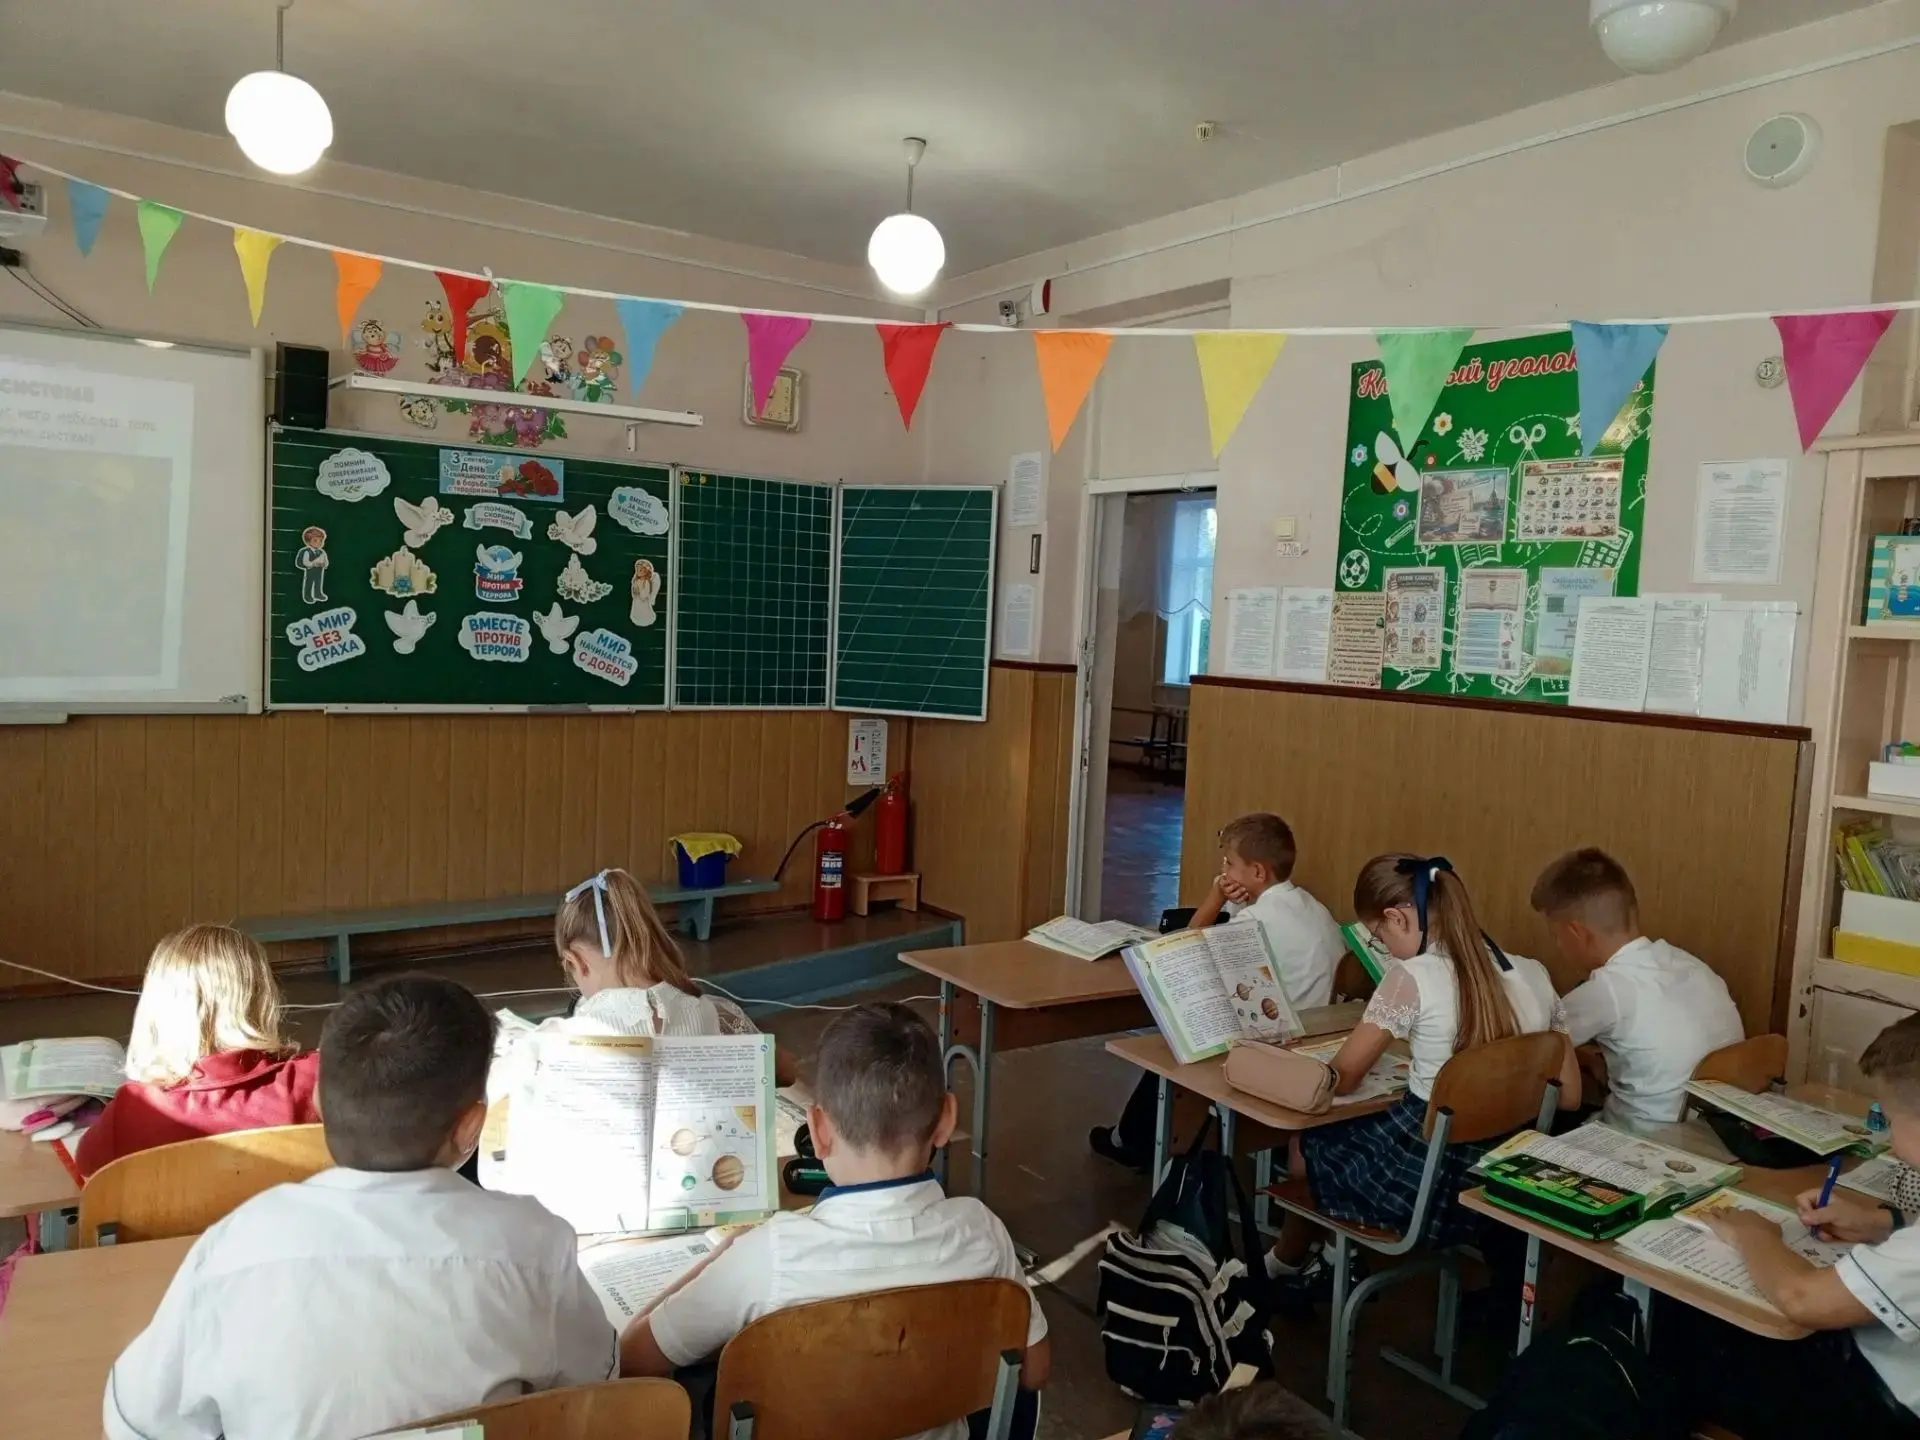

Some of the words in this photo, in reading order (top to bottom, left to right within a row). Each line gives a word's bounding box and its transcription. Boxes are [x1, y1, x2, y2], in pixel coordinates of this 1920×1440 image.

[334, 459, 366, 468] ПОМНИМ
[452, 452, 460, 464] 3
[460, 462, 485, 473] День
[484, 506, 516, 516] ПОМНИМ
[484, 512, 515, 522] СКОРБИМ
[481, 581, 510, 590] ПРОТИВ
[482, 590, 512, 599] ТЕРРОРА
[292, 625, 314, 640] ЗА
[317, 612, 351, 631] МИР
[469, 618, 524, 634] ВМЕСТЕ
[312, 630, 342, 648] БЕЗ
[475, 632, 521, 646] ПРОТИВ
[597, 634, 627, 653] МИР
[303, 639, 359, 666] СТРАХА
[474, 644, 522, 659] ТЕРРОРА
[579, 639, 633, 670] НАЧИНАЕТСЯ
[579, 652, 588, 661] С
[588, 656, 625, 680] ДОБРА
